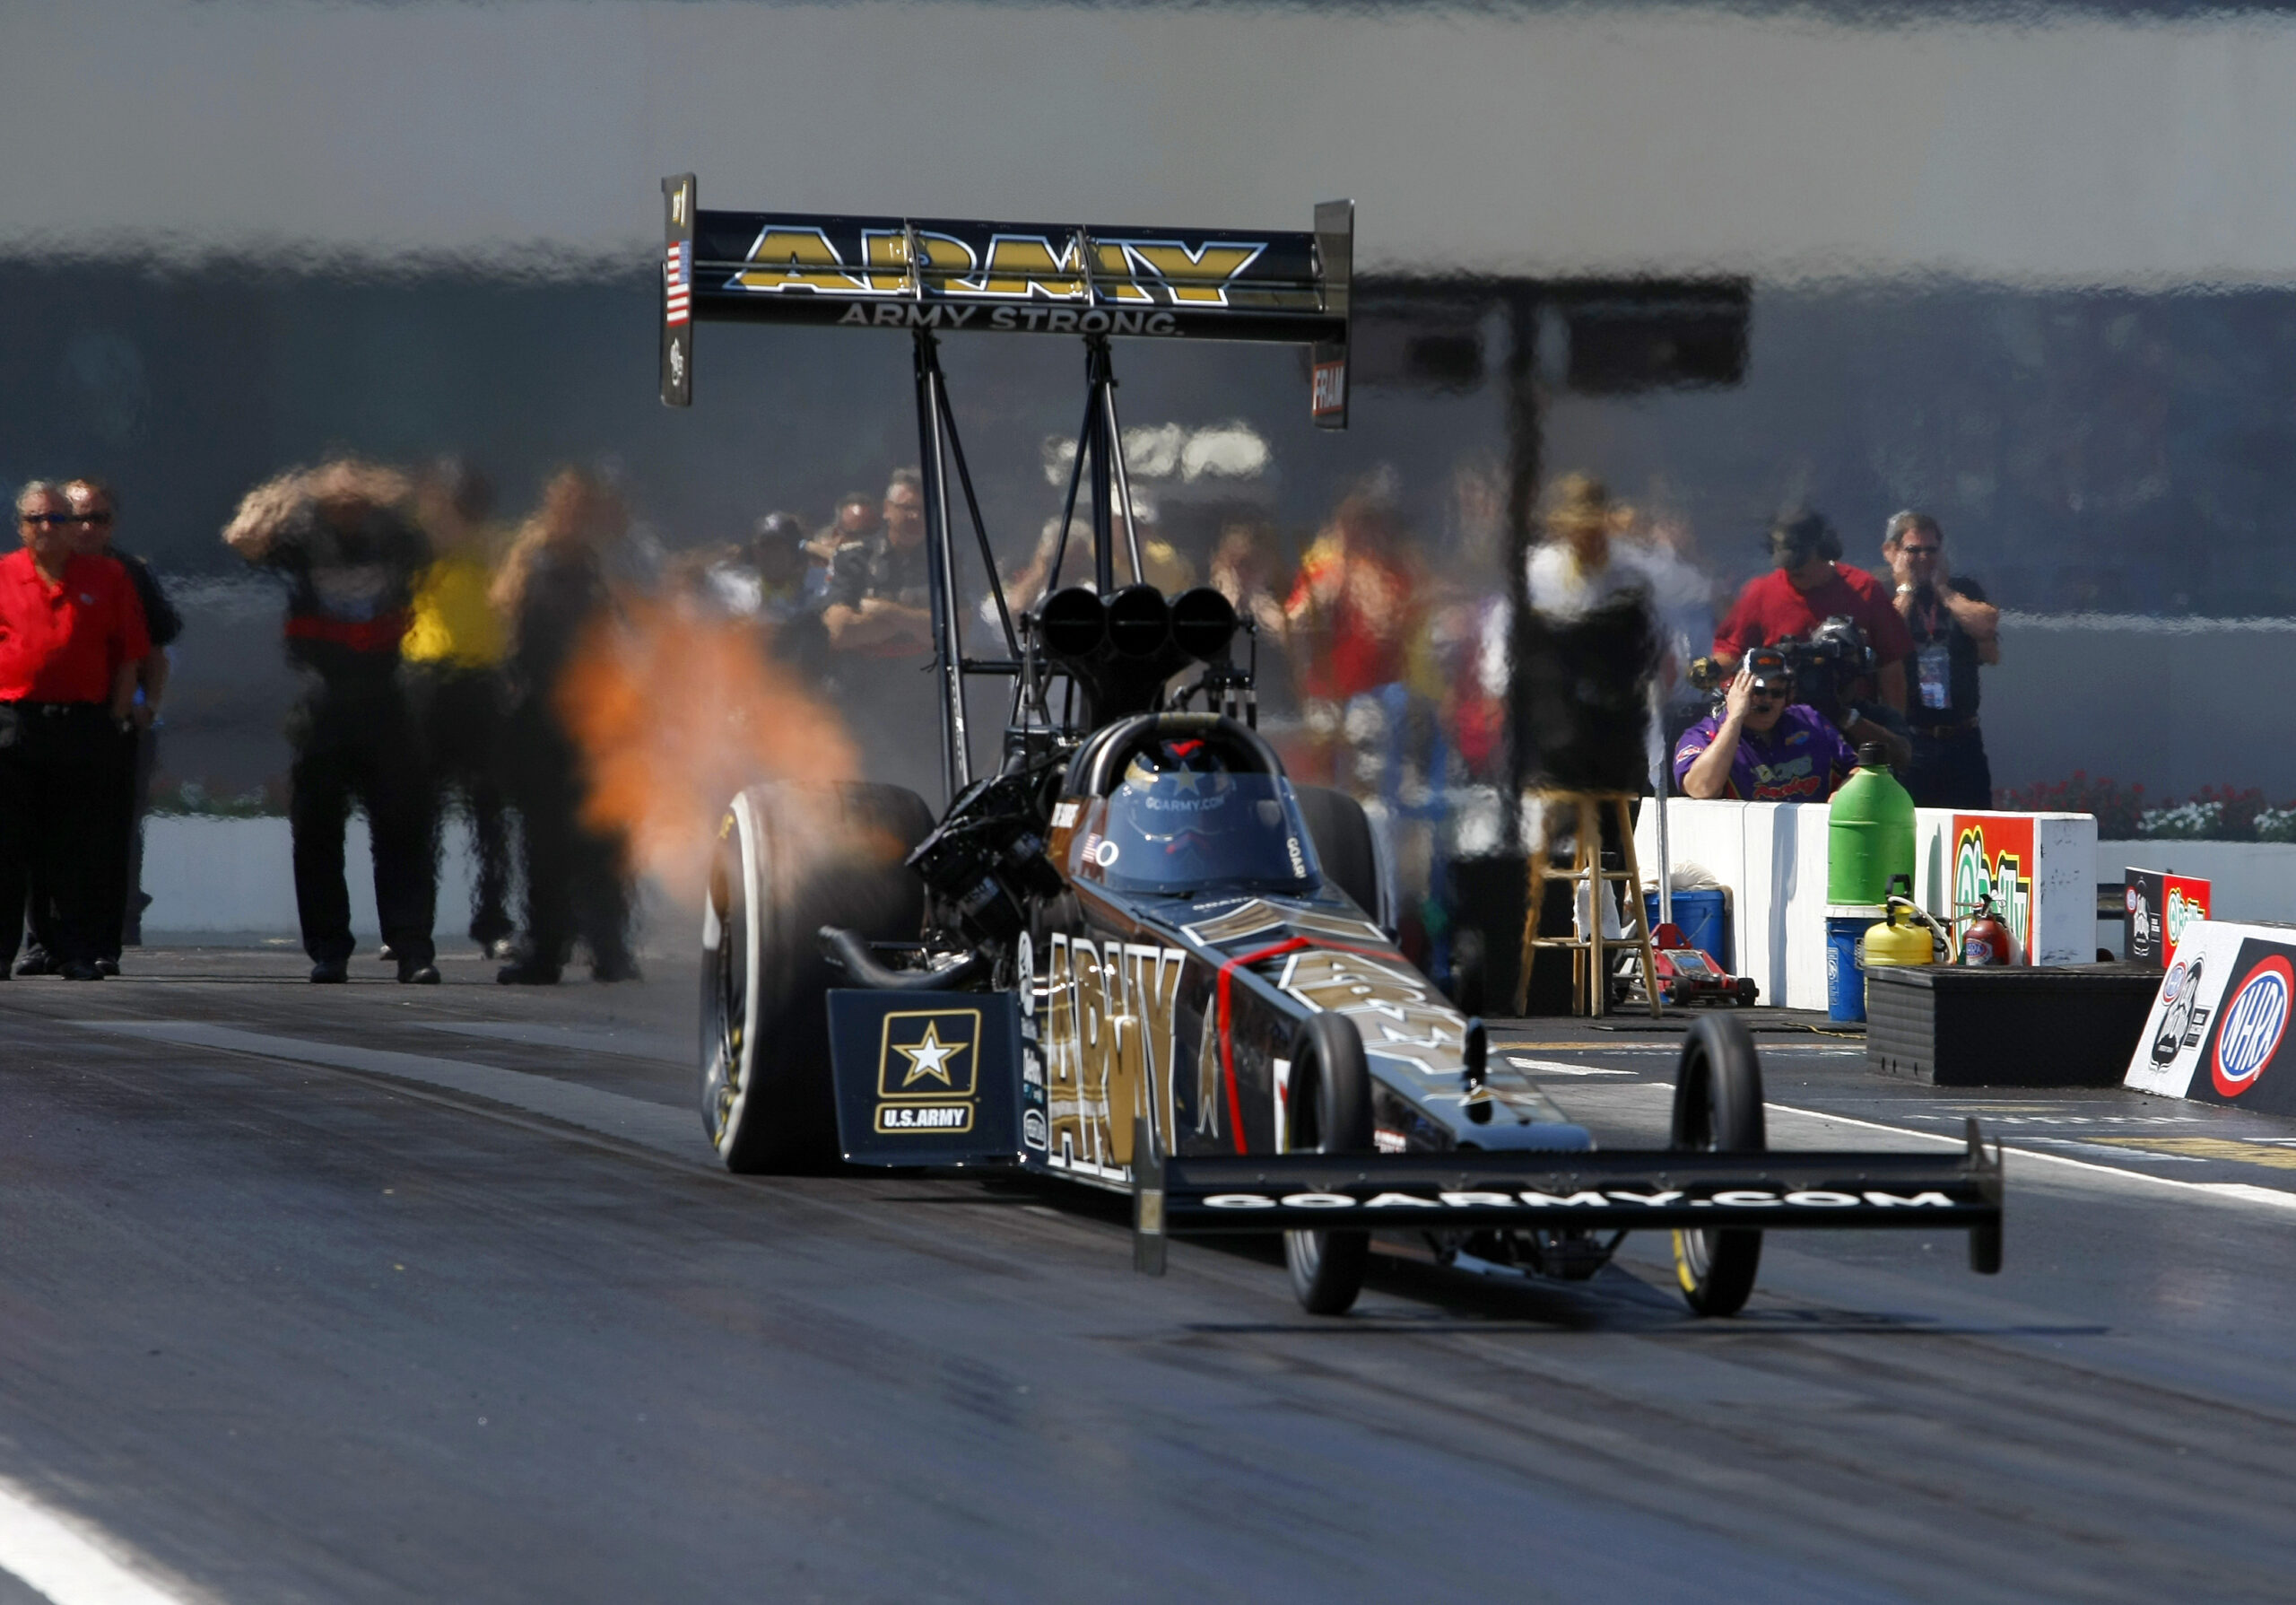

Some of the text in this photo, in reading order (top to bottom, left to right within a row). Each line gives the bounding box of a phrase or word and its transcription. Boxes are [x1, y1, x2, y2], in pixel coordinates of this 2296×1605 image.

[721, 224, 1268, 308] ARMY
[838, 301, 1185, 336] ARMY STRONG.
[1313, 365, 1344, 411] FRAM
[1954, 834, 2031, 962] O'illy
[1048, 933, 1187, 1182] ARMY
[2223, 981, 2283, 1070] NHRA
[1202, 1191, 1955, 1208] GOARMY.COM
